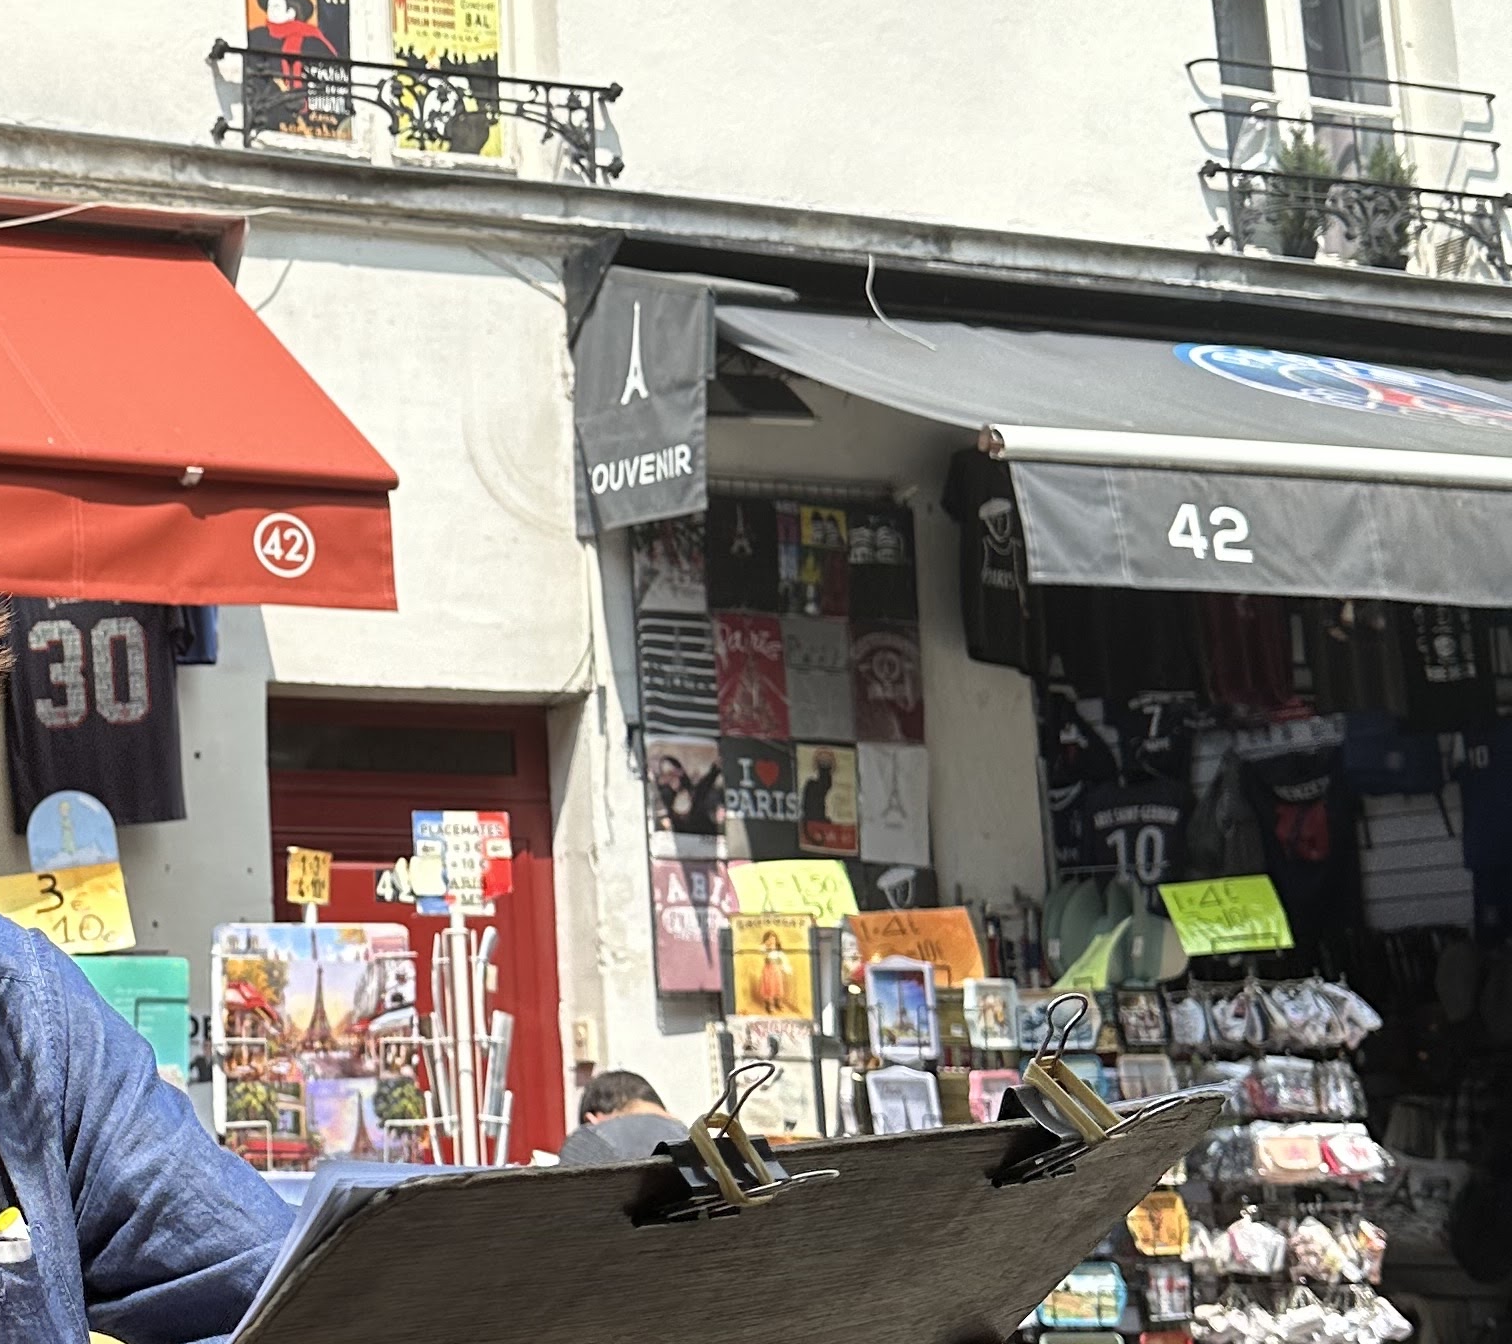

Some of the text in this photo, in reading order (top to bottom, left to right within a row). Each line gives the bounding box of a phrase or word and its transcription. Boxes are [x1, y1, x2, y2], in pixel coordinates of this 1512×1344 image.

[588, 444, 693, 495] OUVENIR
[262, 525, 306, 563] 42
[1168, 503, 1254, 564] 42
[28, 616, 150, 729] 30
[737, 757, 755, 788] I
[723, 787, 802, 823] PARIS
[1105, 824, 1168, 885] 10
